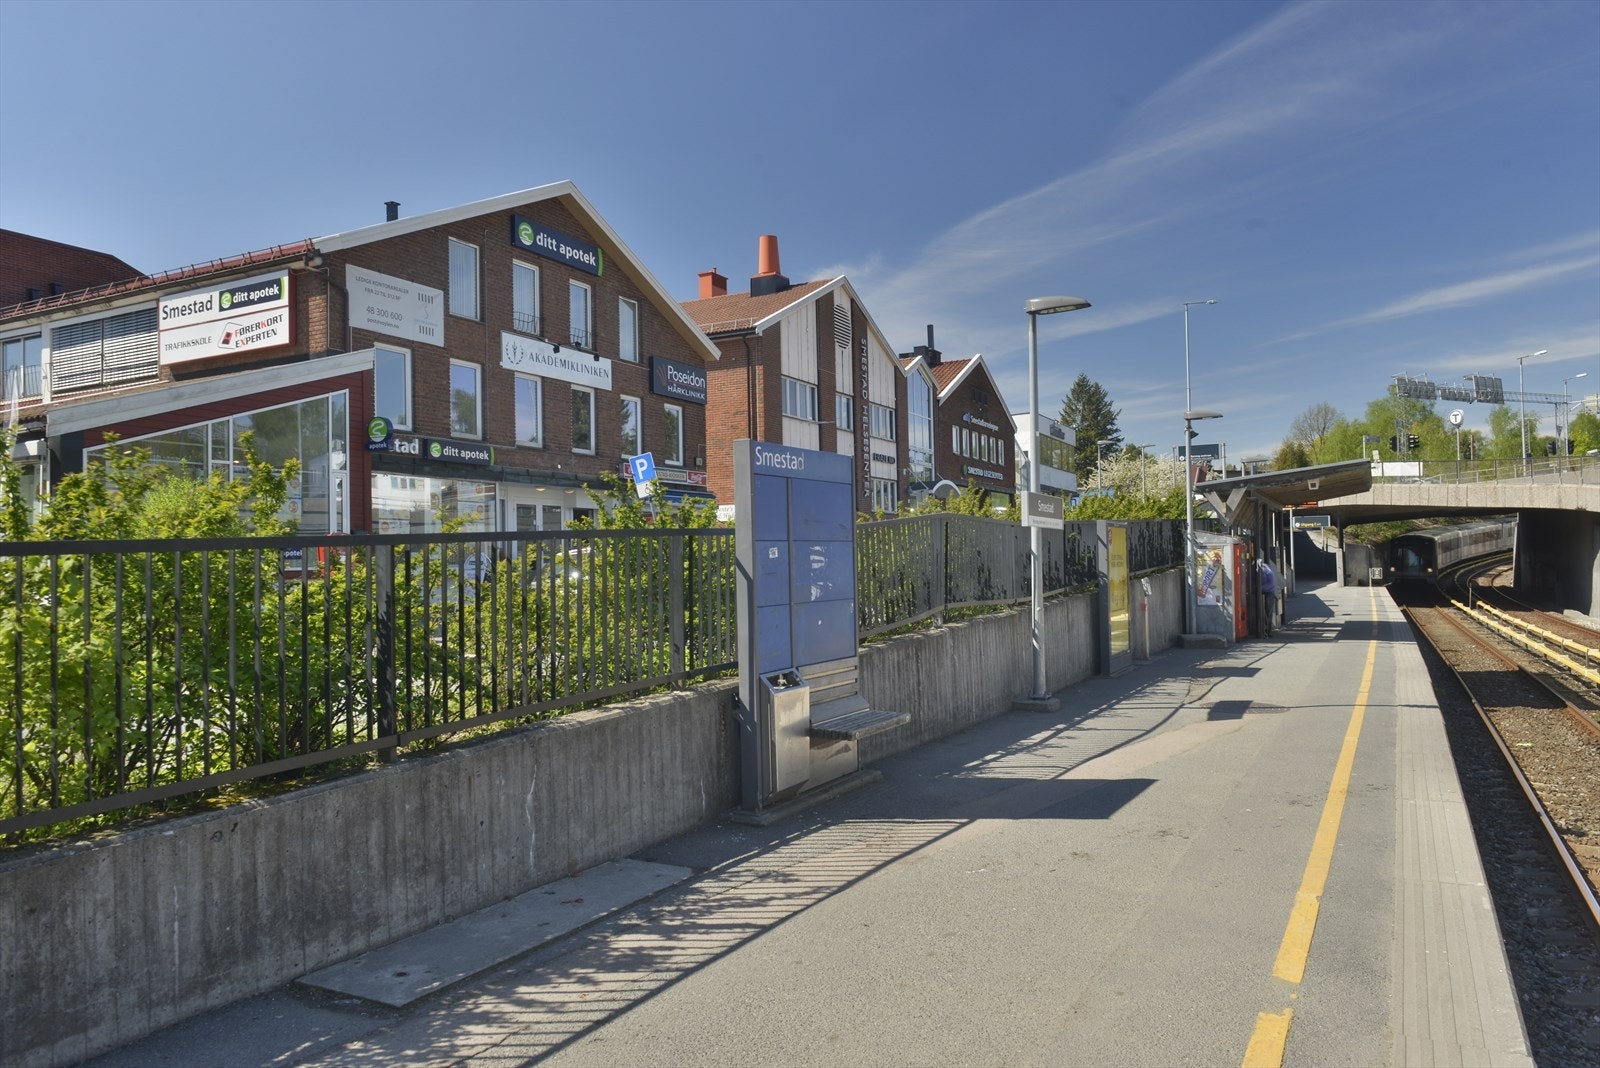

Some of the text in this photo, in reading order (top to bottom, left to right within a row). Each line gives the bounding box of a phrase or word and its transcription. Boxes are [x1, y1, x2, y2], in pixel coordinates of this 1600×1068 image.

[536, 232, 596, 266] ditt apotek
[233, 284, 280, 303] ditt apotek
[162, 295, 213, 320] Smestad
[366, 305, 402, 322] 48 300 600
[234, 314, 284, 338] FØRERKORT
[164, 336, 213, 351] TRAFIKKSKOLE
[235, 328, 278, 348] EXPERTEN
[529, 352, 609, 378] AKADEMIKLINIKEN
[667, 365, 706, 389] Poseidon
[667, 383, 706, 399] HÅRKLINIKK
[1452, 413, 1460, 422] T
[368, 442, 387, 450] apotek
[390, 439, 419, 455] tad
[443, 446, 489, 460] ditt apotek
[862, 405, 870, 497] HELSESENTER
[755, 446, 805, 470] Smestad
[635, 458, 648, 480] P
